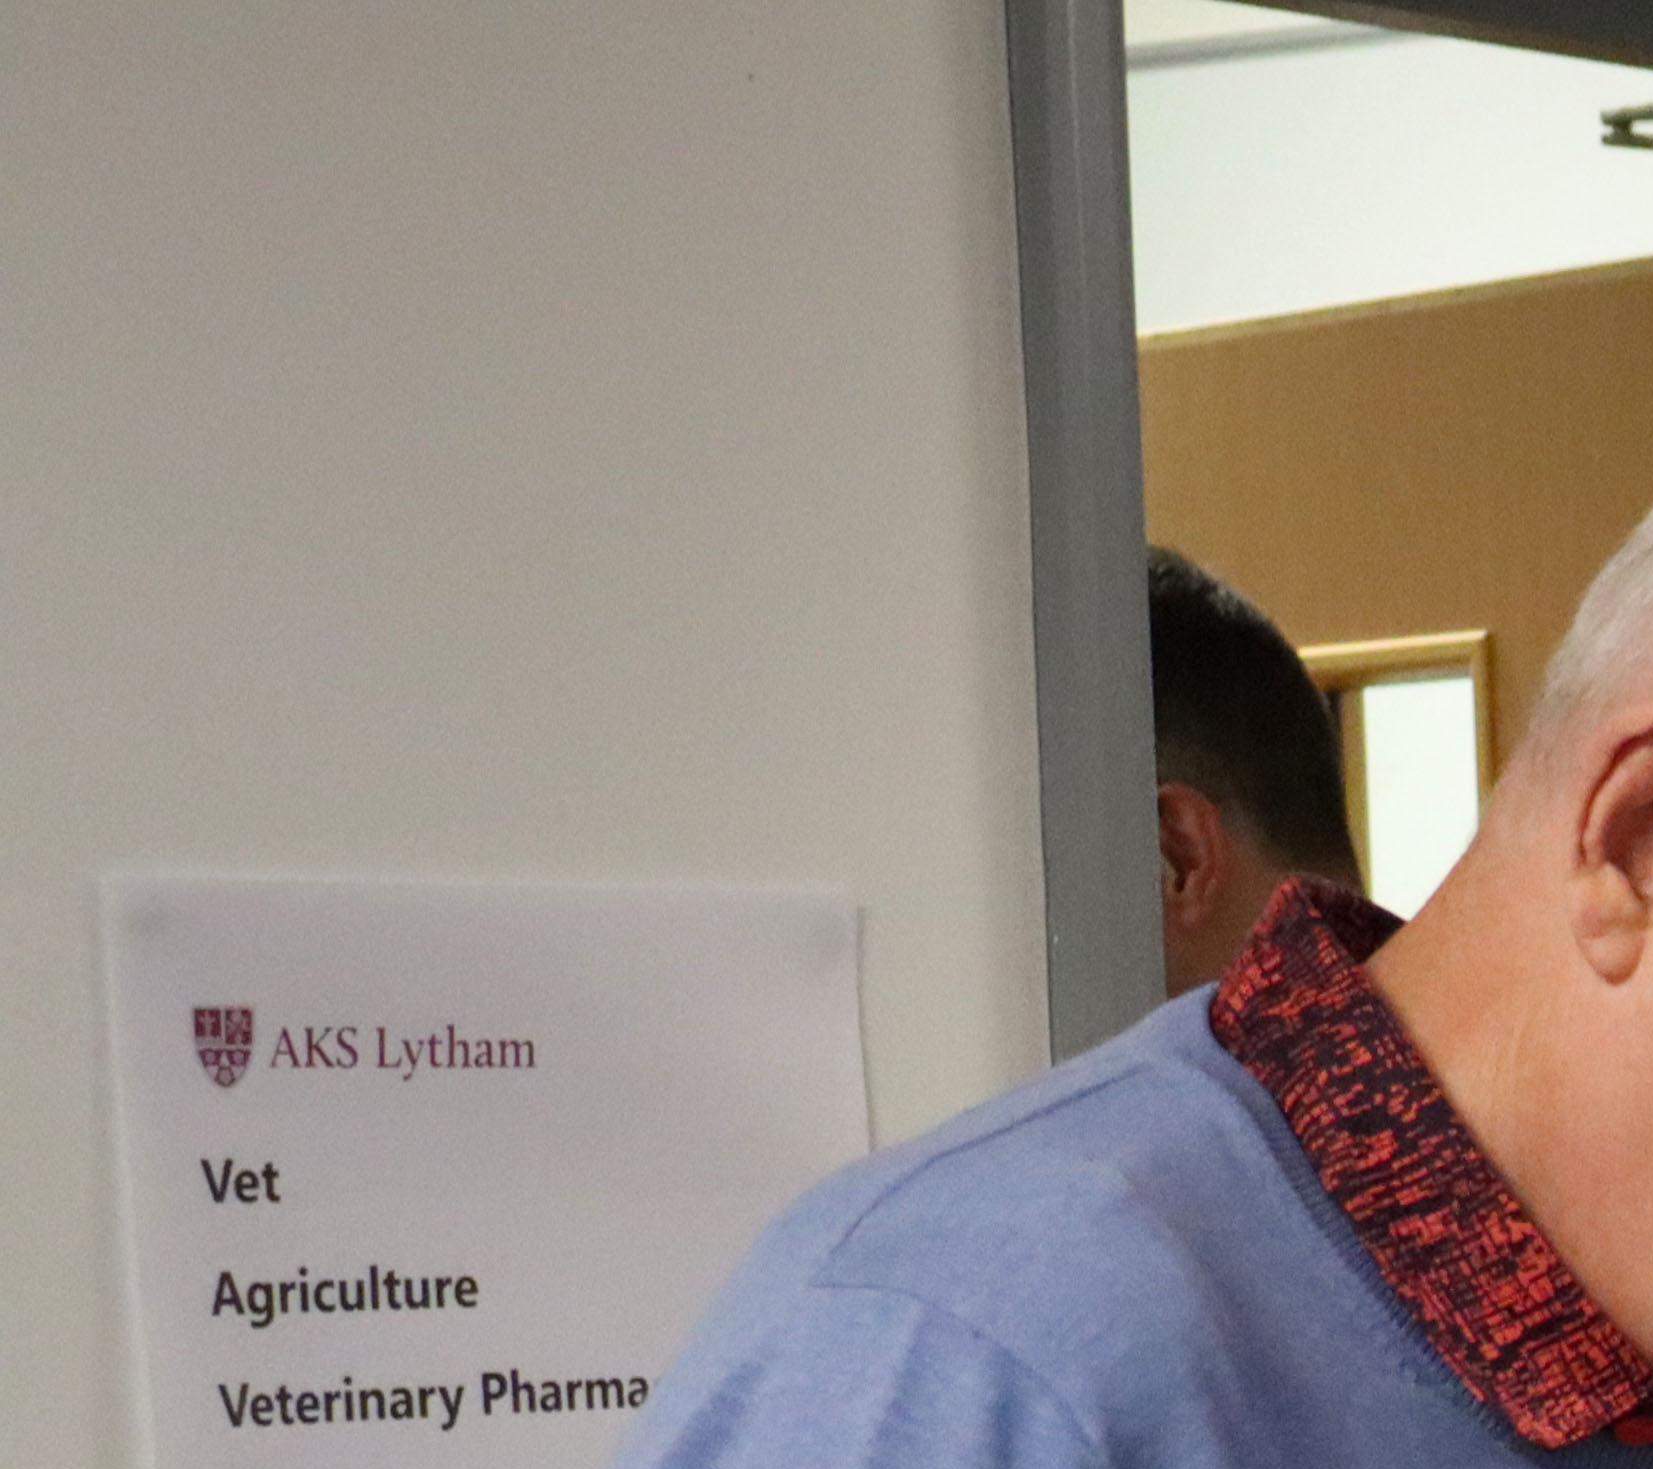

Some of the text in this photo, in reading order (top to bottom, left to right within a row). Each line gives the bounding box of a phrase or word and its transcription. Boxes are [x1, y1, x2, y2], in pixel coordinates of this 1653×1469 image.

[270, 1024, 538, 1082] AKS Lytham
[200, 1158, 281, 1204] Vet
[211, 1265, 479, 1329] Agriculture
[218, 1376, 464, 1431] Veterinary
